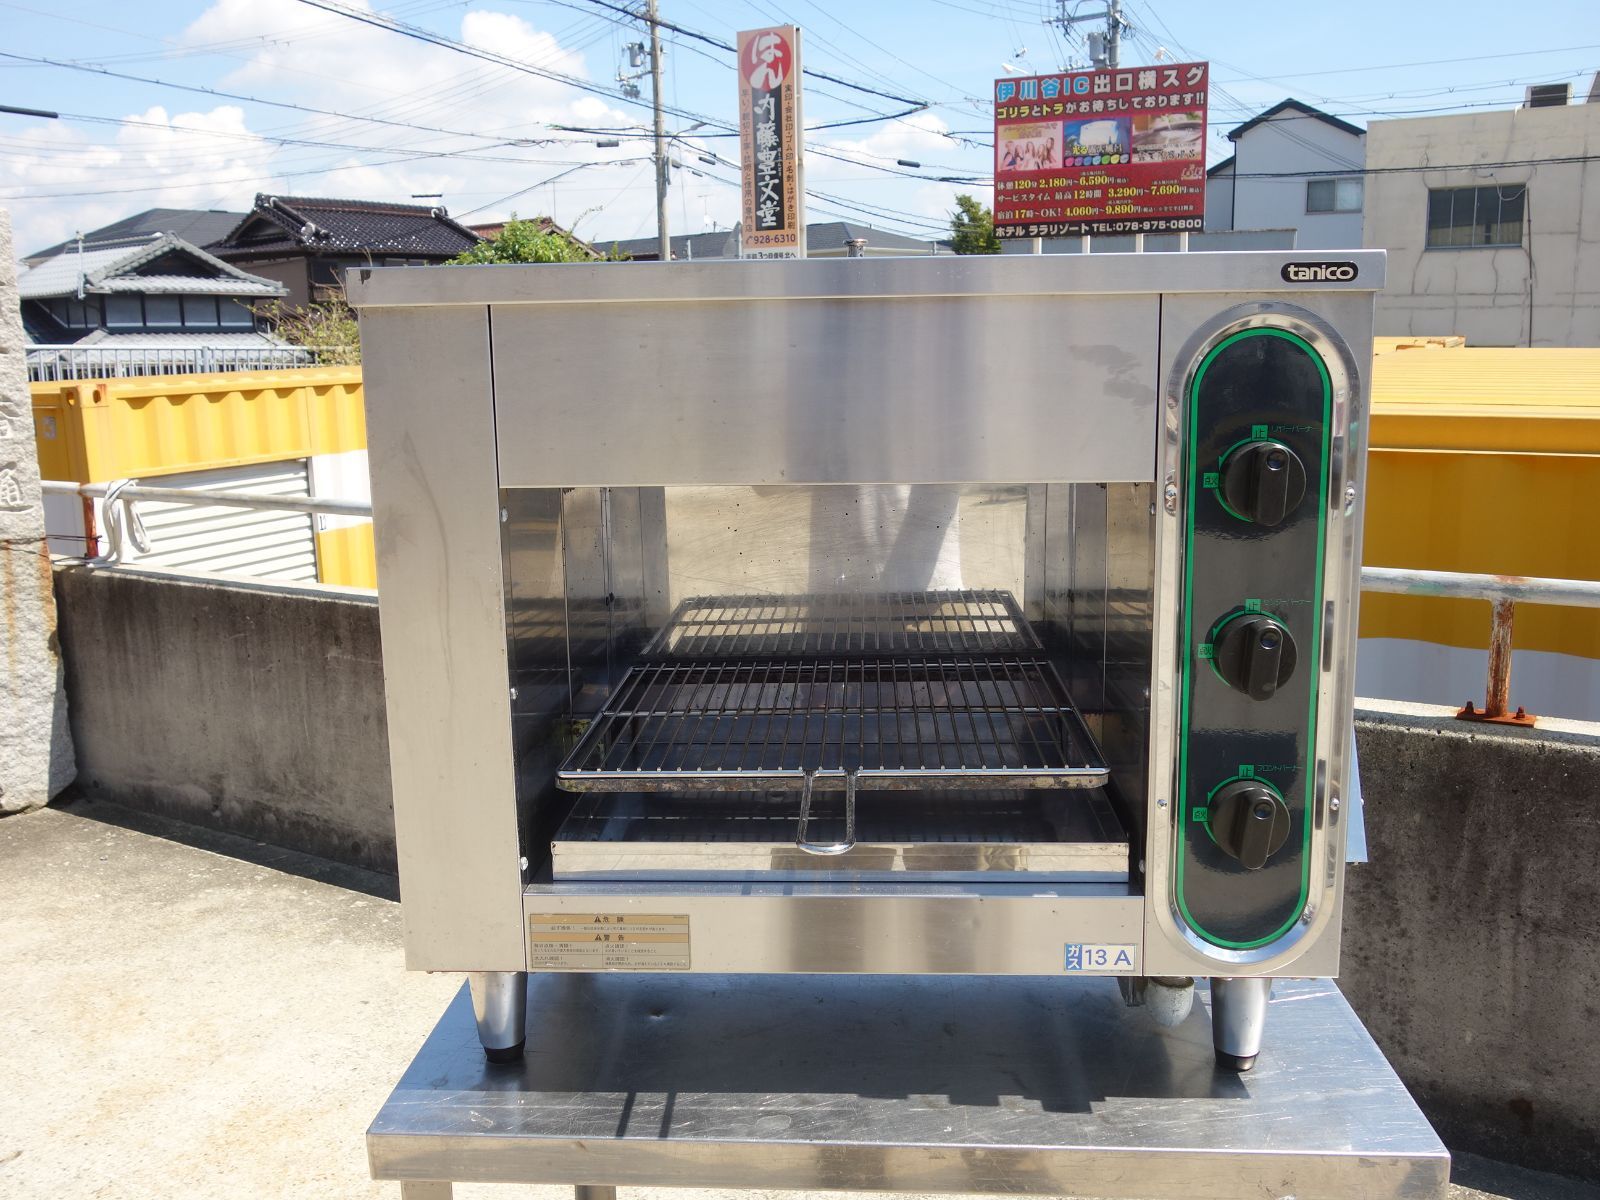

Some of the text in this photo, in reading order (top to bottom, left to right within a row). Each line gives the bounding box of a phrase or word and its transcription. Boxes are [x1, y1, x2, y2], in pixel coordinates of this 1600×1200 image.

[751, 32, 783, 90] はん
[996, 226, 1025, 237] ホテル
[1029, 223, 1089, 235] ララリゾート
[754, 234, 796, 244] 928-6310
[1288, 265, 1354, 280] tanico
[1068, 945, 1080, 969] ガス
